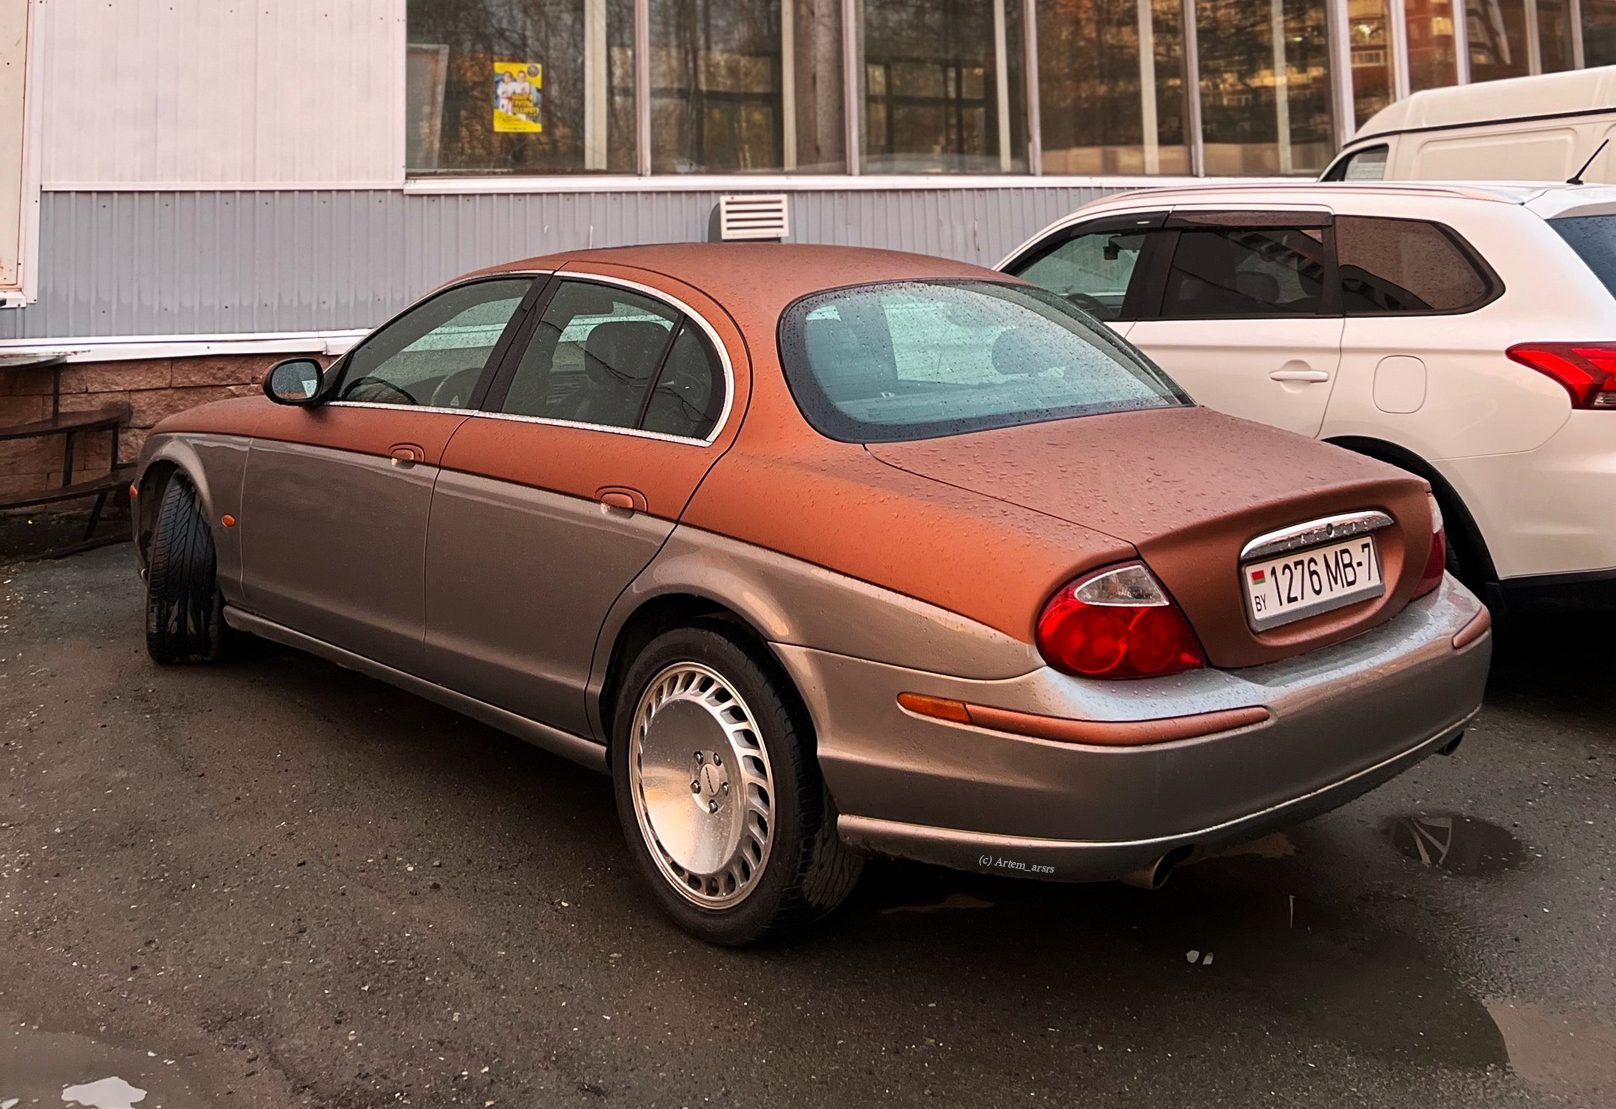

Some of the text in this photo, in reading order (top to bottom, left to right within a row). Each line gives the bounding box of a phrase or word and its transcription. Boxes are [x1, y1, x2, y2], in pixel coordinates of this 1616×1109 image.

[1270, 542, 1370, 606] 1276 MB-7
[1254, 594, 1267, 612] BY
